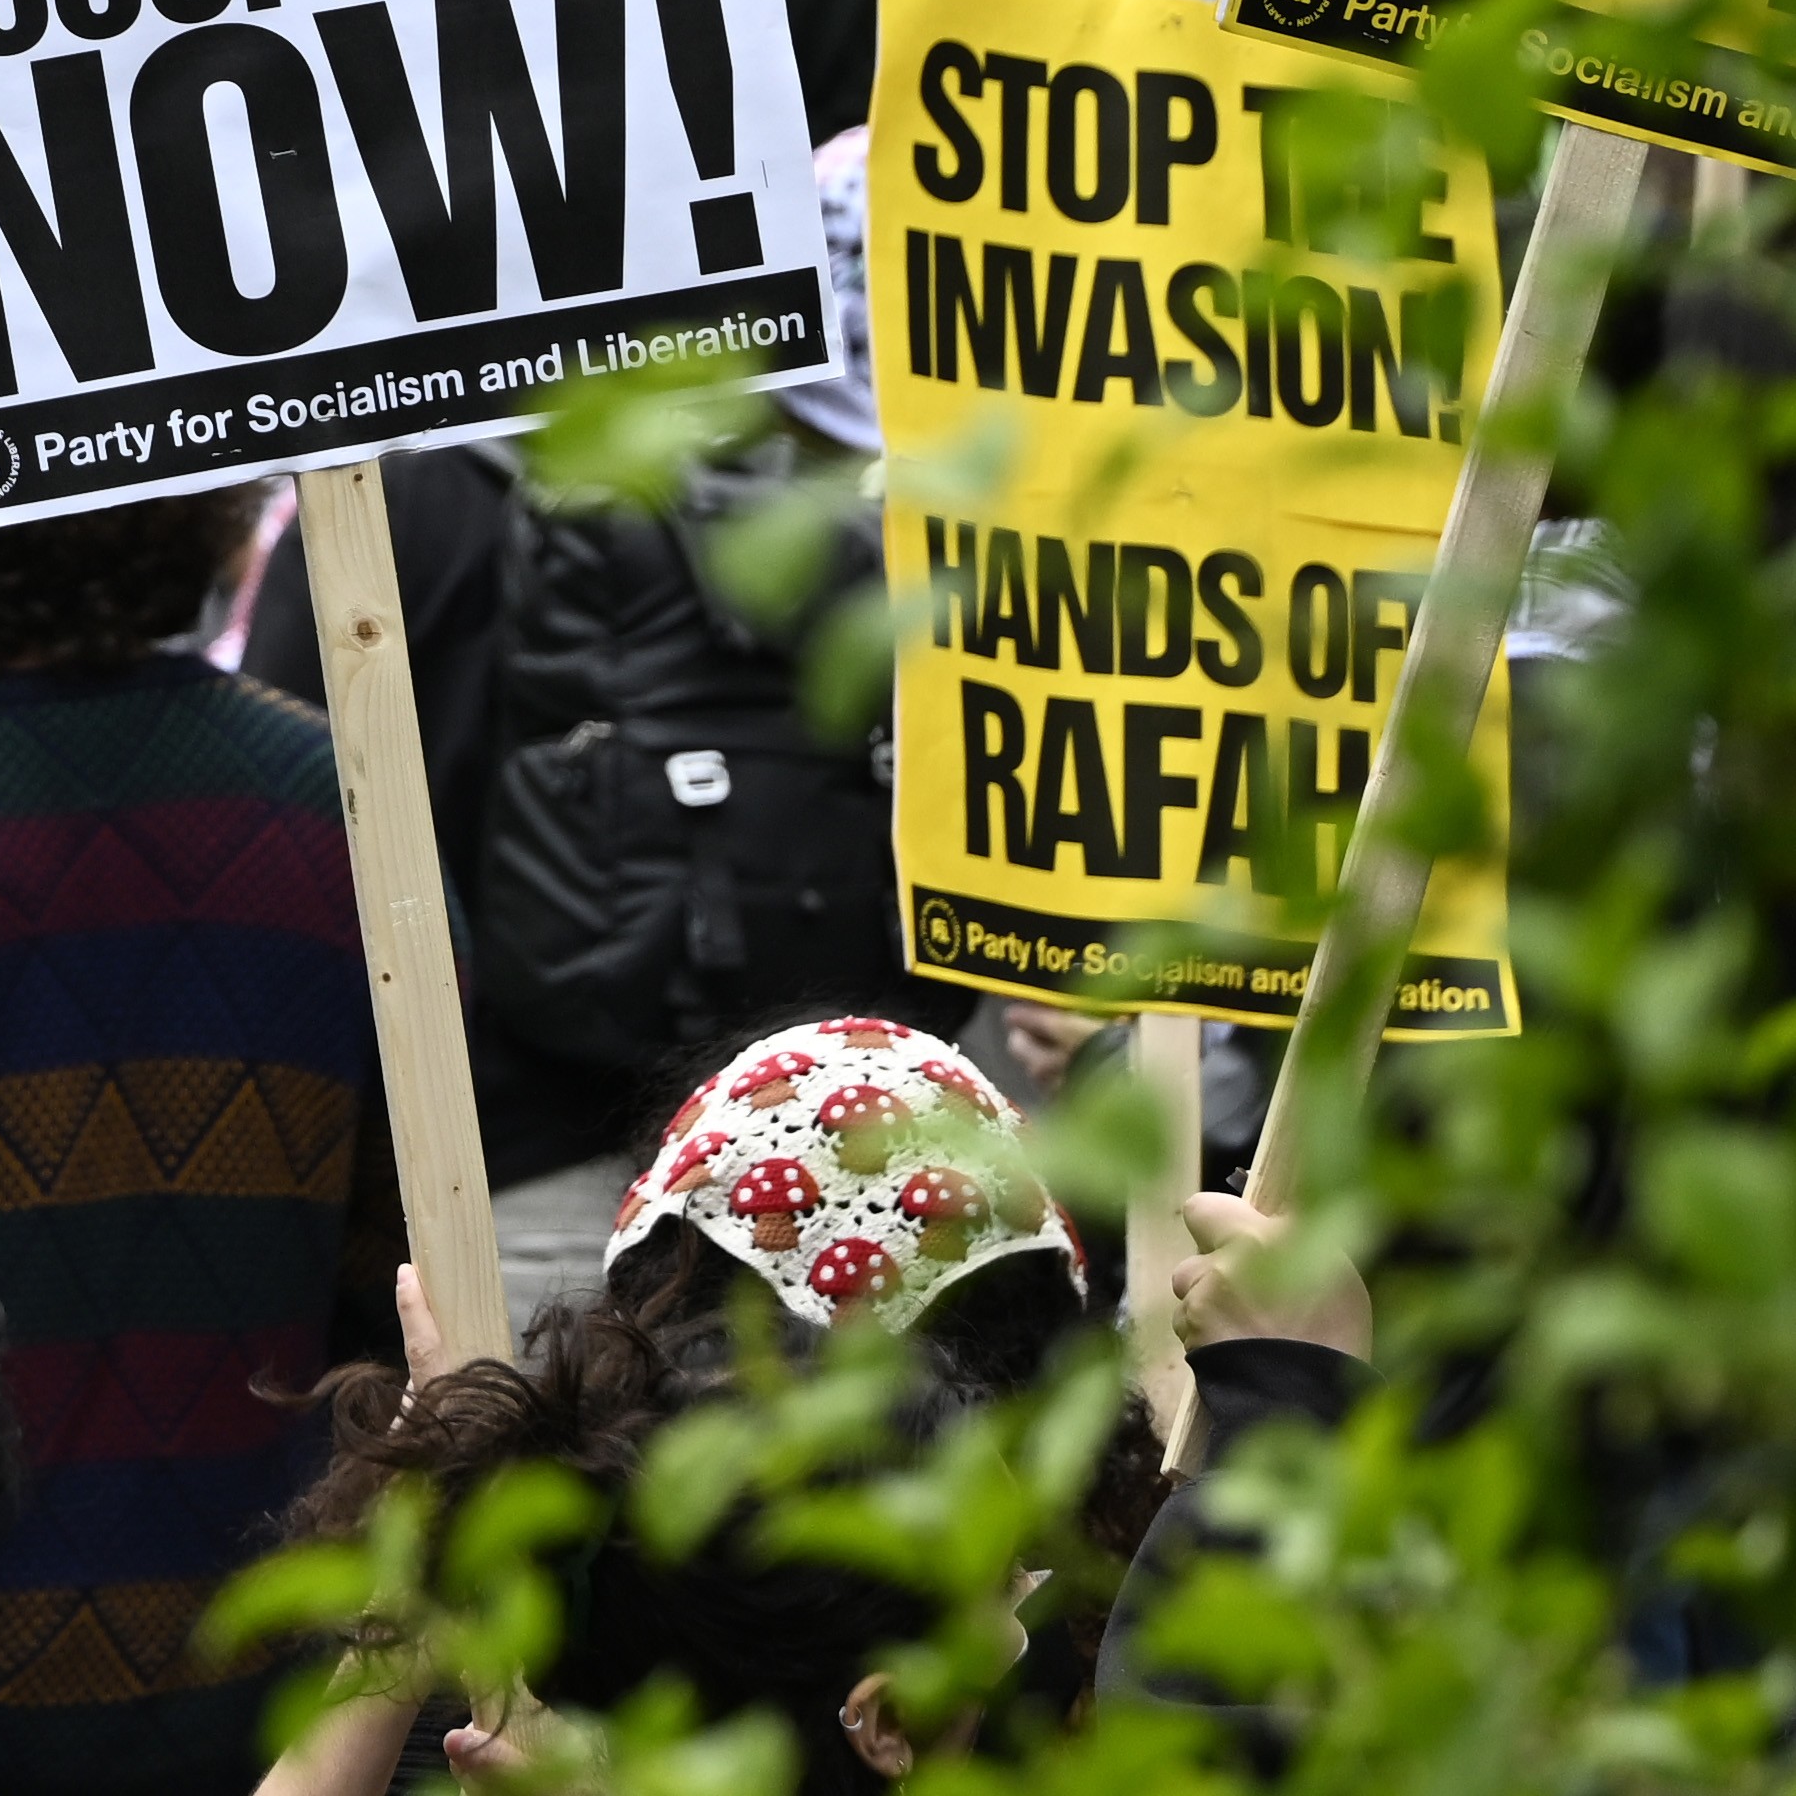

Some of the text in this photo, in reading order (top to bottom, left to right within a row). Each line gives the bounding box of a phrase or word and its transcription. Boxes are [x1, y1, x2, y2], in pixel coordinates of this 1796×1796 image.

[912, 40, 1219, 226] STOP
[1737, 98, 1796, 140] an
[34, 310, 807, 472] Party for Socialism and Liberation
[925, 513, 1432, 703] HANDS OF
[961, 679, 1371, 898] RAFAH
[965, 921, 1032, 972] Party
[1035, 936, 1077, 973] for
